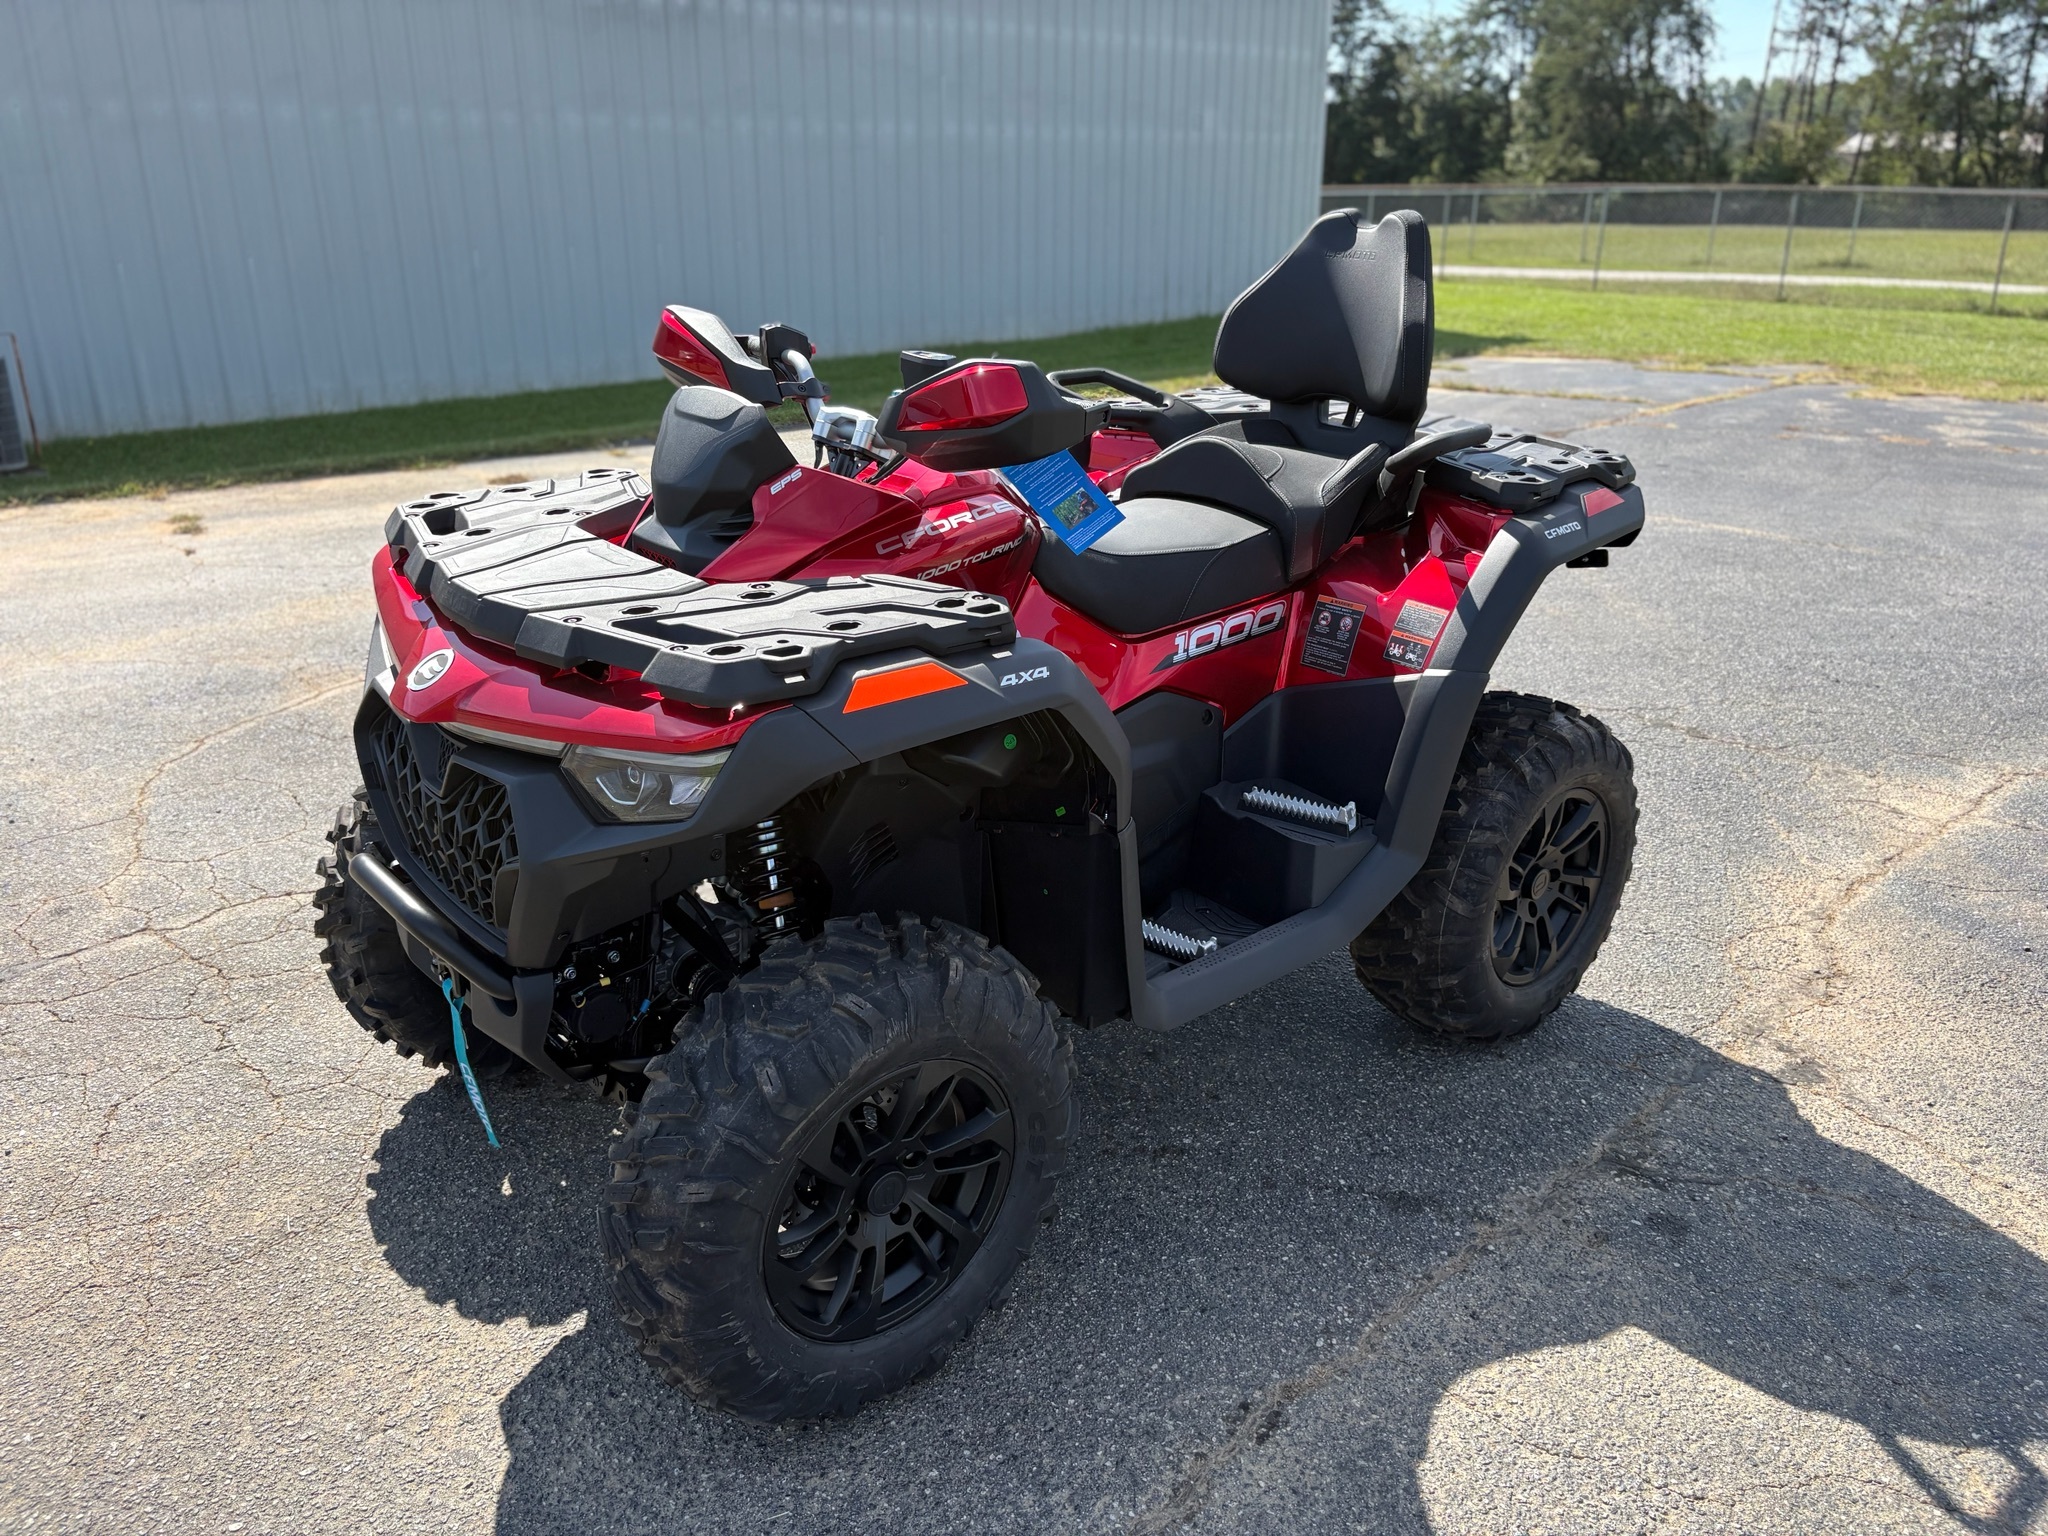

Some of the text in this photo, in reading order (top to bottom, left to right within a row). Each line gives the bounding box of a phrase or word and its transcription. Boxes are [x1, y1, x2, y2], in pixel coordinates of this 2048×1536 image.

[770, 468, 802, 495] EPS
[875, 500, 1016, 555] CFORCE
[1544, 521, 1582, 539] CFMOTO
[1173, 599, 1287, 663] 1000
[460, 1061, 493, 1133] CFMOTO
